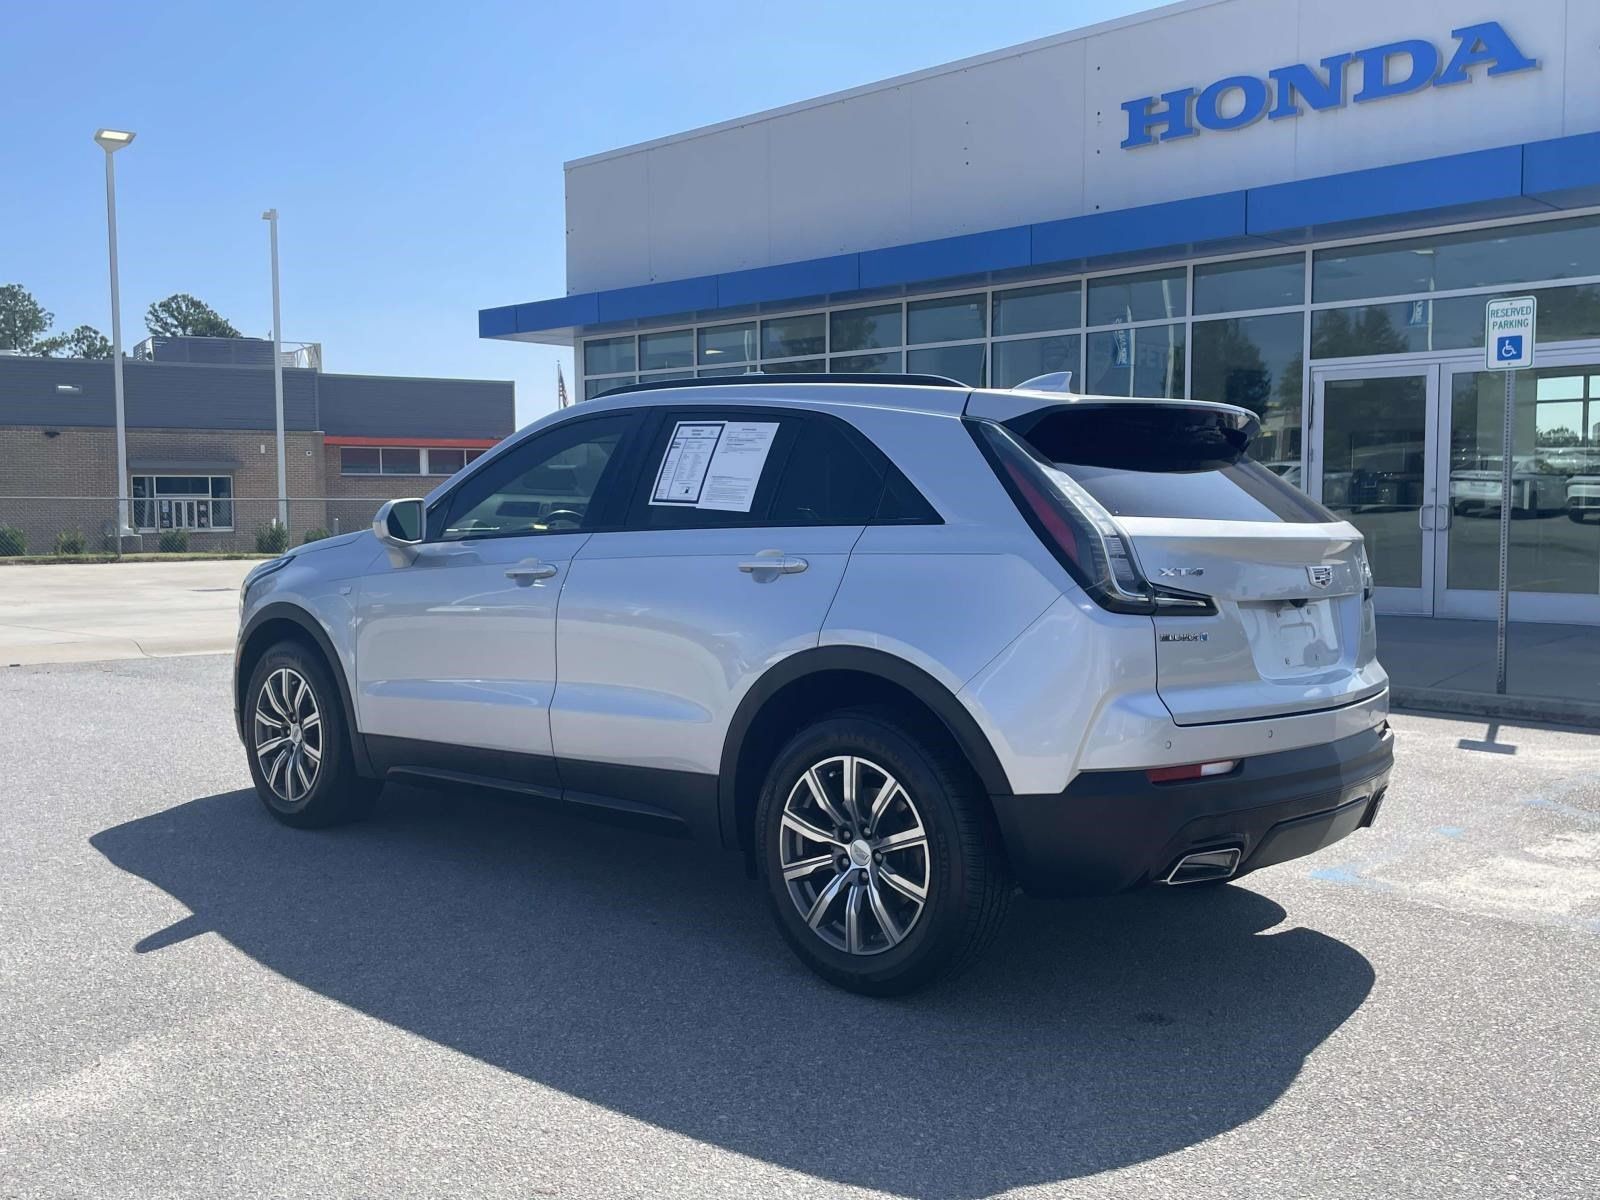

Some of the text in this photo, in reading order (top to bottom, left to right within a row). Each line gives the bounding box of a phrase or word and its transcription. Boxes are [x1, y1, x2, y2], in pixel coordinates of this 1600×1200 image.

[1121, 21, 1539, 150] HONDA
[1491, 306, 1531, 318] RESERVED
[1492, 318, 1528, 330] PARKING
[1159, 567, 1204, 577] XT4
